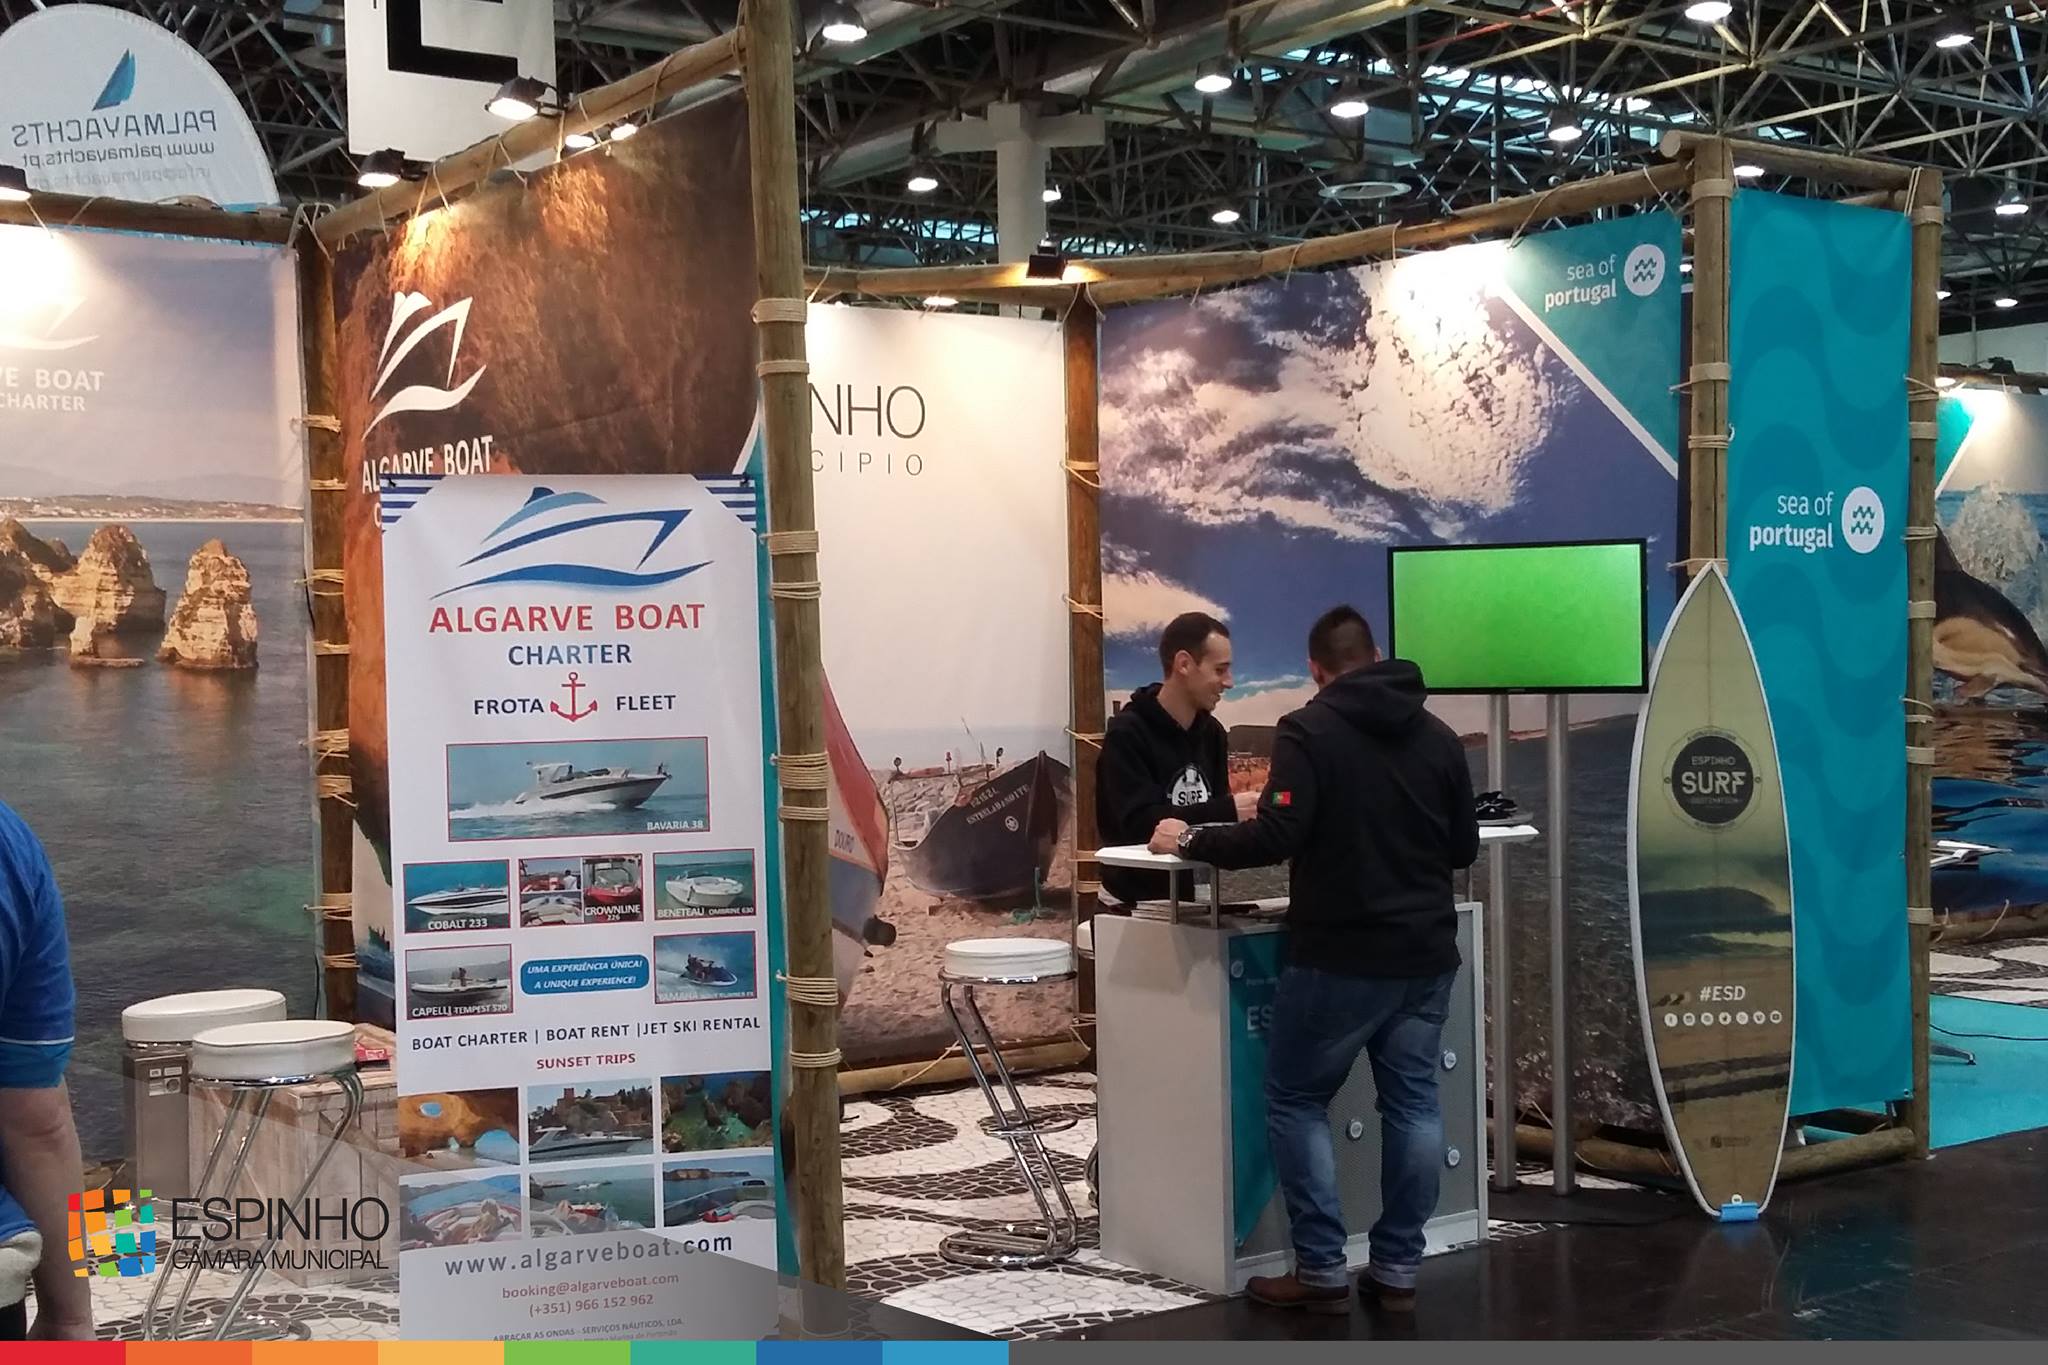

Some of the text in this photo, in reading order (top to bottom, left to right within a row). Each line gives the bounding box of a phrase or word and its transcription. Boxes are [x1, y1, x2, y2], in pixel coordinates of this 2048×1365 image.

[1567, 254, 1617, 281] sea of
[1545, 278, 1617, 313] portugal
[35, 368, 104, 391] BOAT
[443, 434, 493, 475] BOAT
[1777, 491, 1834, 516] sea of
[1749, 522, 1834, 553] portugal
[428, 603, 706, 634] ALGARVE BOAT
[507, 643, 633, 667] CHARTER
[473, 694, 677, 716] FROTA FLEET
[1681, 770, 1746, 795] SURF
[647, 819, 704, 831] BAVARIA 38
[584, 904, 641, 917] CROWNLINE
[657, 907, 706, 919] BENETEAU
[427, 918, 488, 931] COBALT 233
[527, 964, 550, 975] UMA
[534, 981, 542, 989] A
[543, 979, 579, 990] UNIQUE
[1699, 985, 1746, 1002] #ESD
[412, 1036, 453, 1051] BOAT
[457, 1031, 528, 1047] CHARTER
[546, 1027, 587, 1042] BOAT
[591, 1024, 630, 1038] RENT
[673, 1019, 698, 1033] SKI
[702, 1016, 761, 1031] RENTAL
[536, 1053, 636, 1070] SUNSET TRIPS
[445, 1235, 734, 1276] www.algarveboat.com
[502, 1272, 680, 1300] booking@algarveboat.com
[529, 1294, 654, 1318] (+351) 966 152 962
